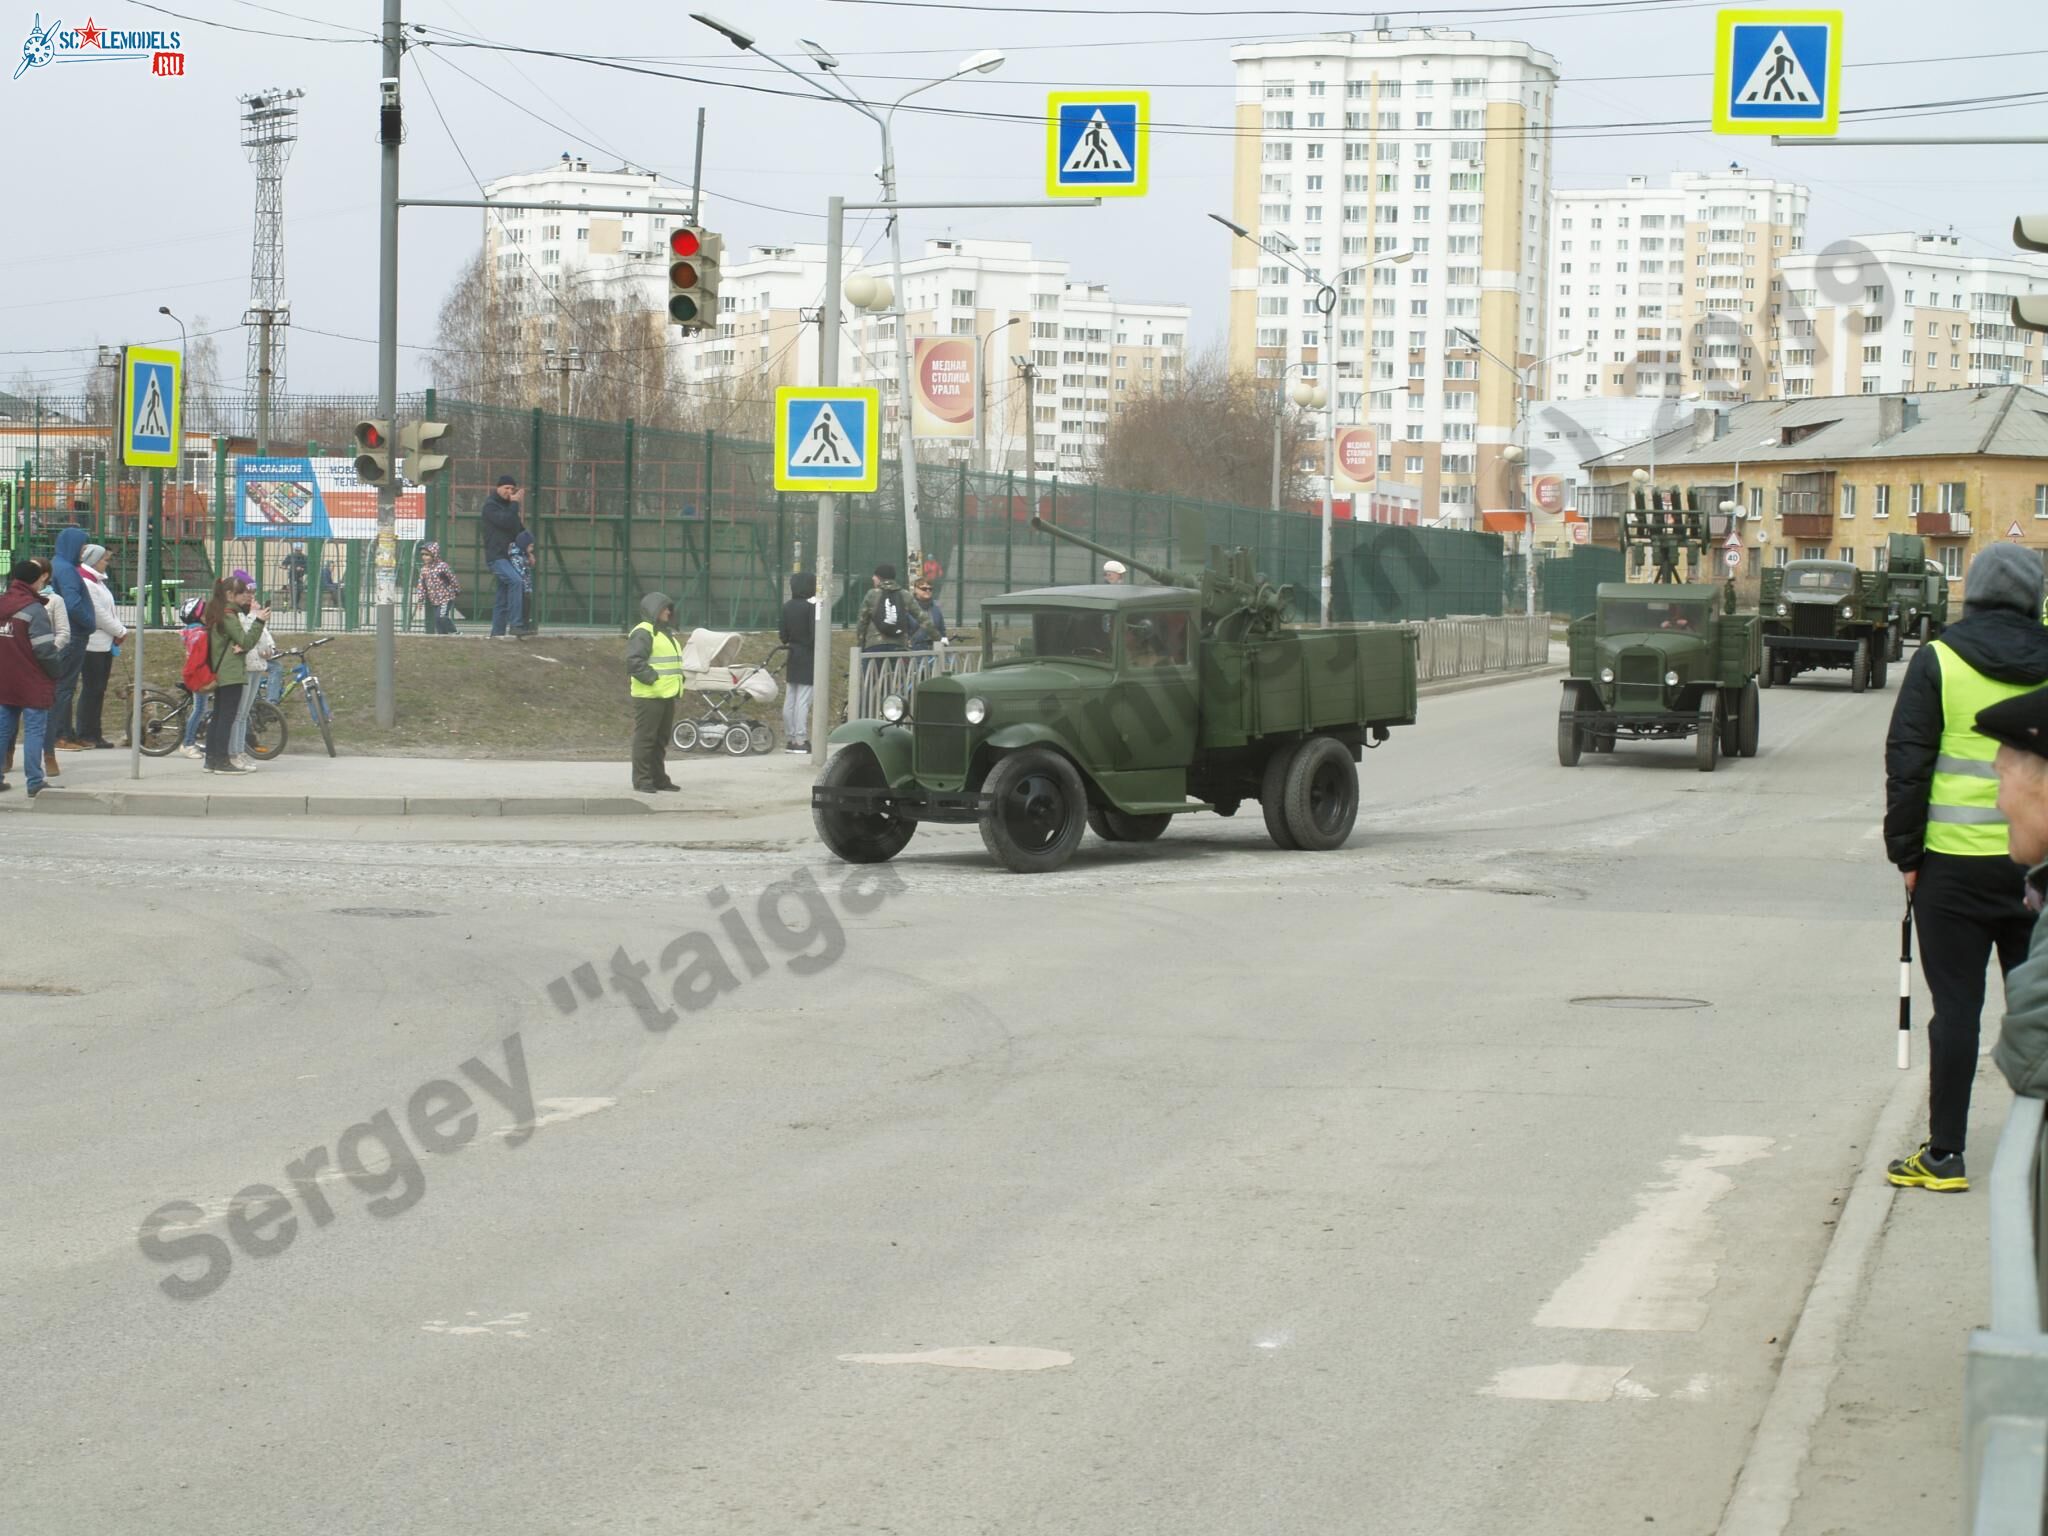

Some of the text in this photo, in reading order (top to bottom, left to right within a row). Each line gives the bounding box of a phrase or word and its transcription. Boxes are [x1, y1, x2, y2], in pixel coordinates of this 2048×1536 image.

[932, 360, 967, 371] МЕДНАЯ
[932, 372, 970, 384] СТОЛИЦА
[932, 385, 960, 395] УРАЛА
[244, 464, 303, 473] НА СЛАДКОЕ
[1728, 554, 1738, 562] 40
